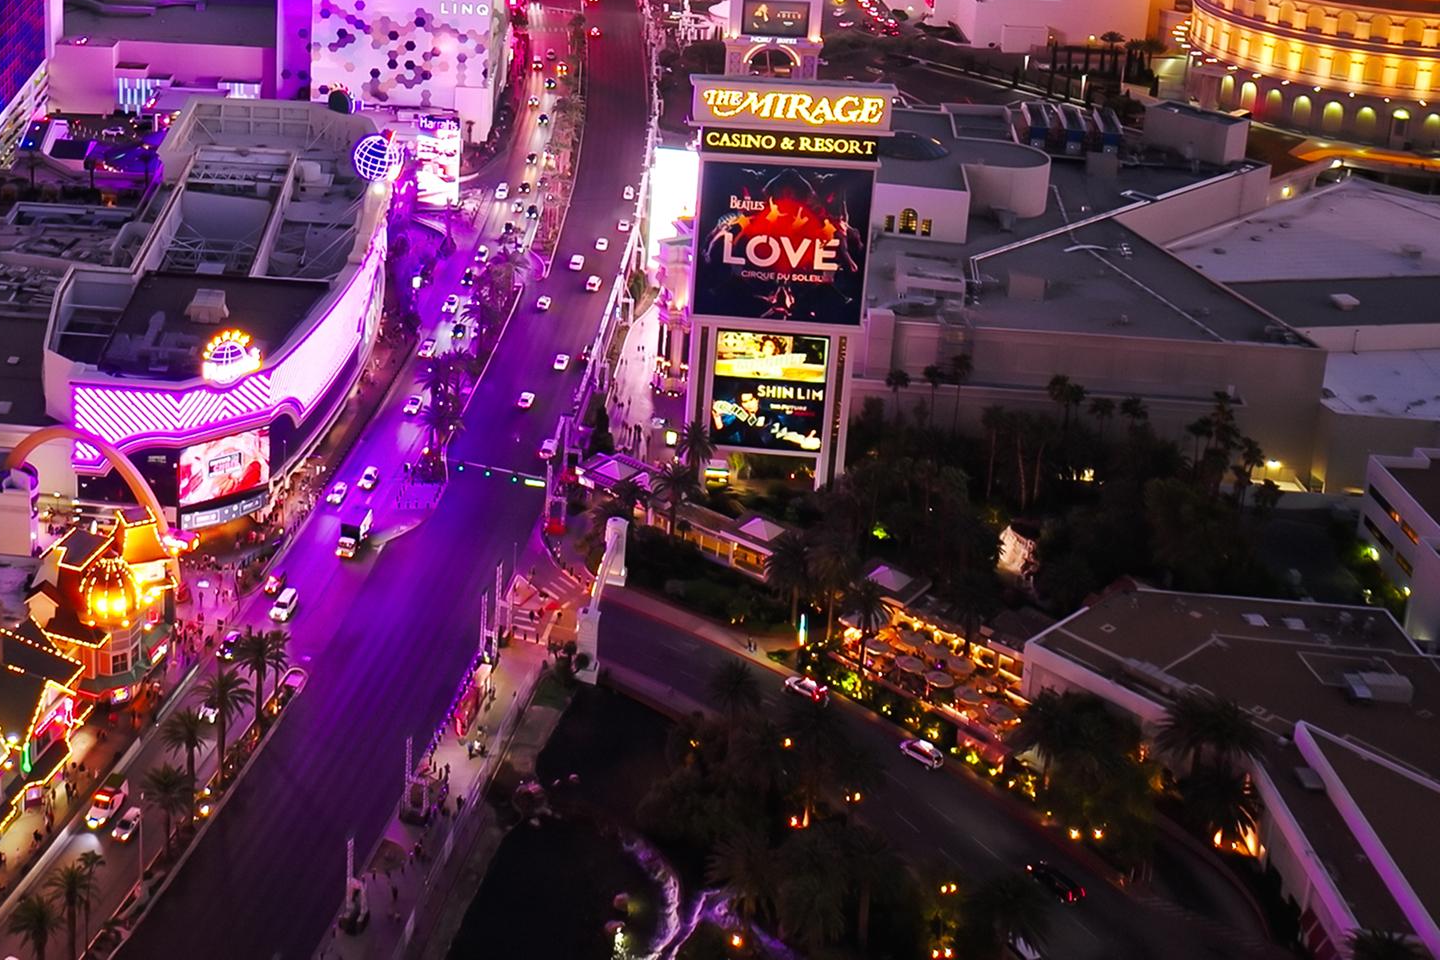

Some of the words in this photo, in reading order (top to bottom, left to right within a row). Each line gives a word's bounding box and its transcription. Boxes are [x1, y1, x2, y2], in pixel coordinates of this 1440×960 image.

[440, 2, 489, 16] LINQ
[703, 89, 742, 106] THE
[714, 91, 885, 125] MIRAGE
[706, 131, 776, 150] CASINO
[780, 136, 795, 151] &
[798, 136, 877, 155] RESORT
[729, 195, 765, 211] BEATLES
[722, 231, 841, 272] LOVE
[741, 270, 775, 281] CIRQUE
[776, 272, 790, 281] DU
[791, 273, 823, 283] SOLEIL
[757, 384, 794, 400] SHIN
[797, 387, 824, 401] LIM
